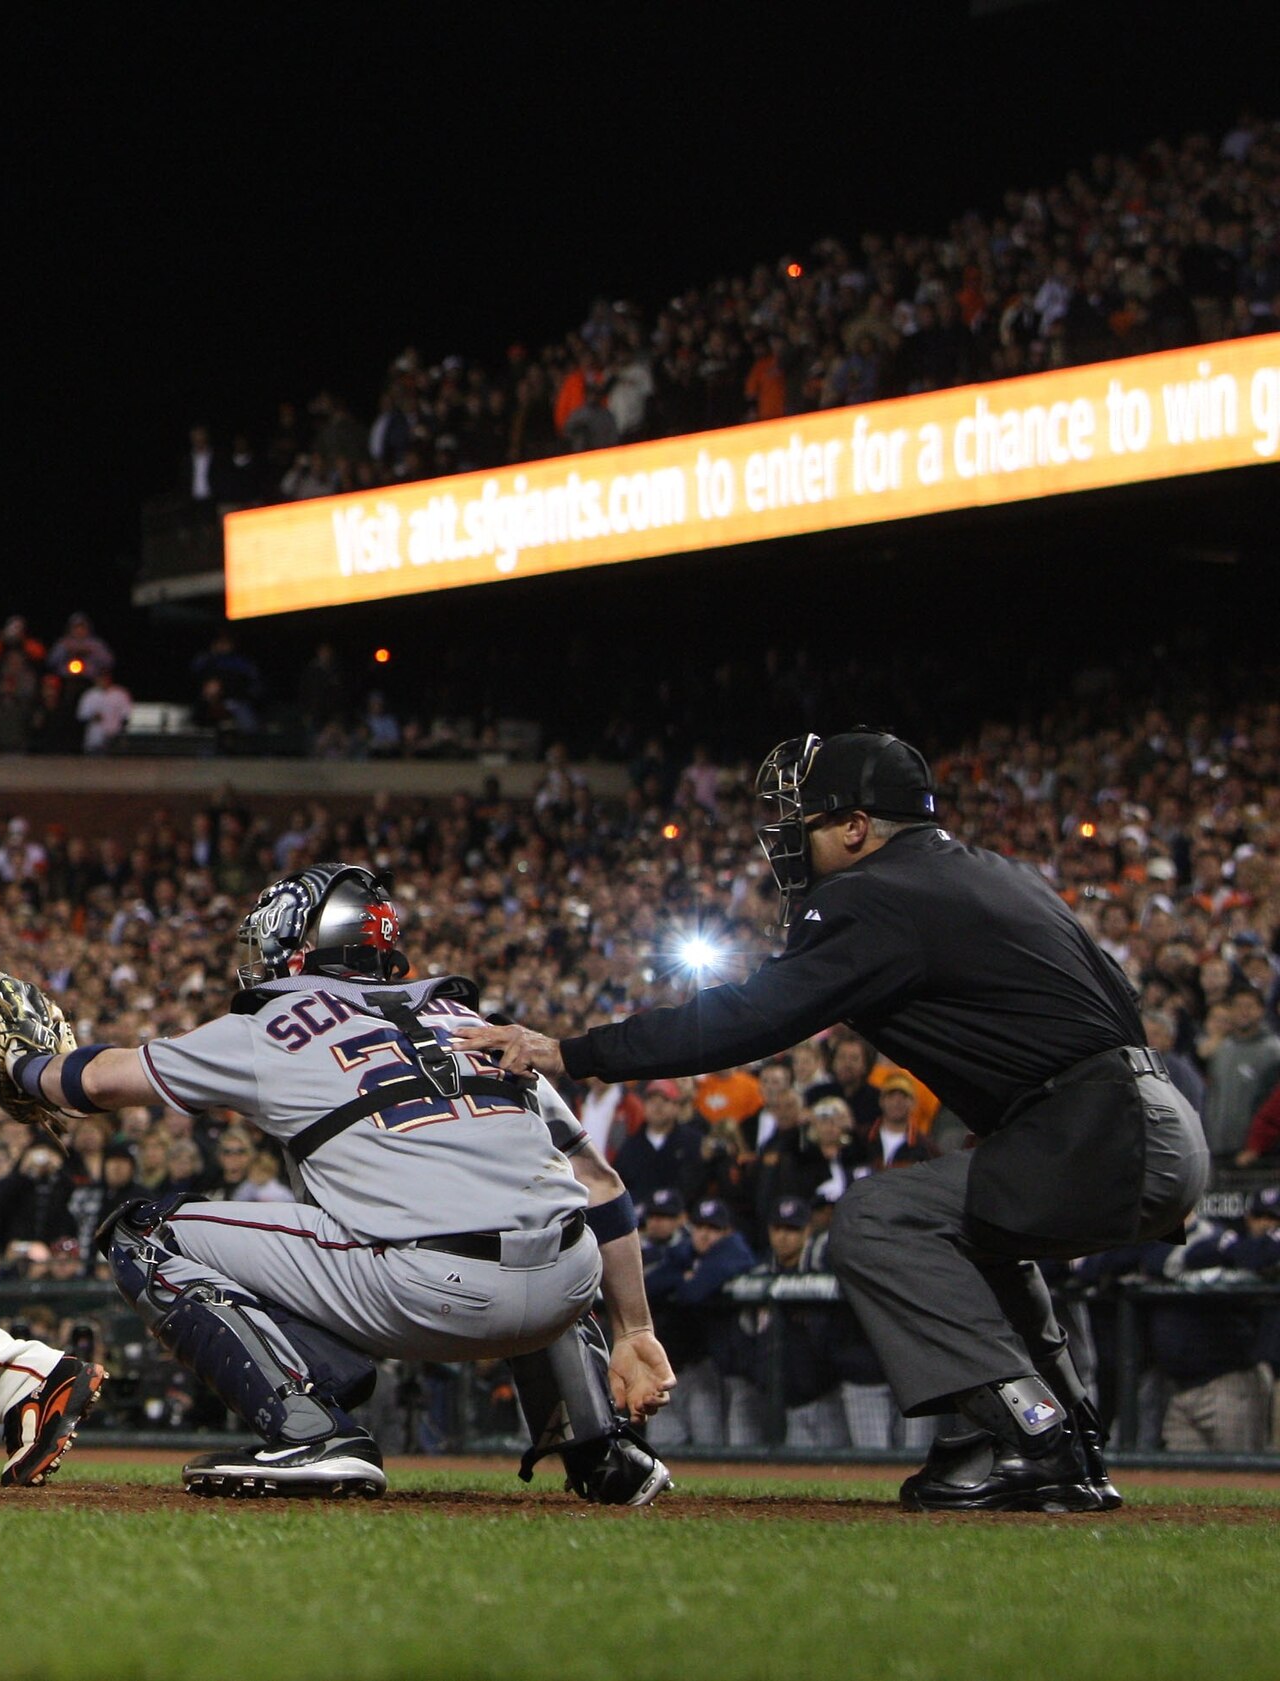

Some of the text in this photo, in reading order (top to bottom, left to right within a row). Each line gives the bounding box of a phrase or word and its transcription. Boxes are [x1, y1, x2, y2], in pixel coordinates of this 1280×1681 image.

[332, 503, 402, 577] Visit
[407, 473, 686, 573] att.sfgiants.com
[694, 450, 735, 520] to
[743, 434, 842, 512] enter
[850, 415, 909, 494] for
[917, 422, 943, 485] a
[953, 397, 1096, 478] chance
[1105, 379, 1152, 454] to
[1162, 361, 1238, 445] win
